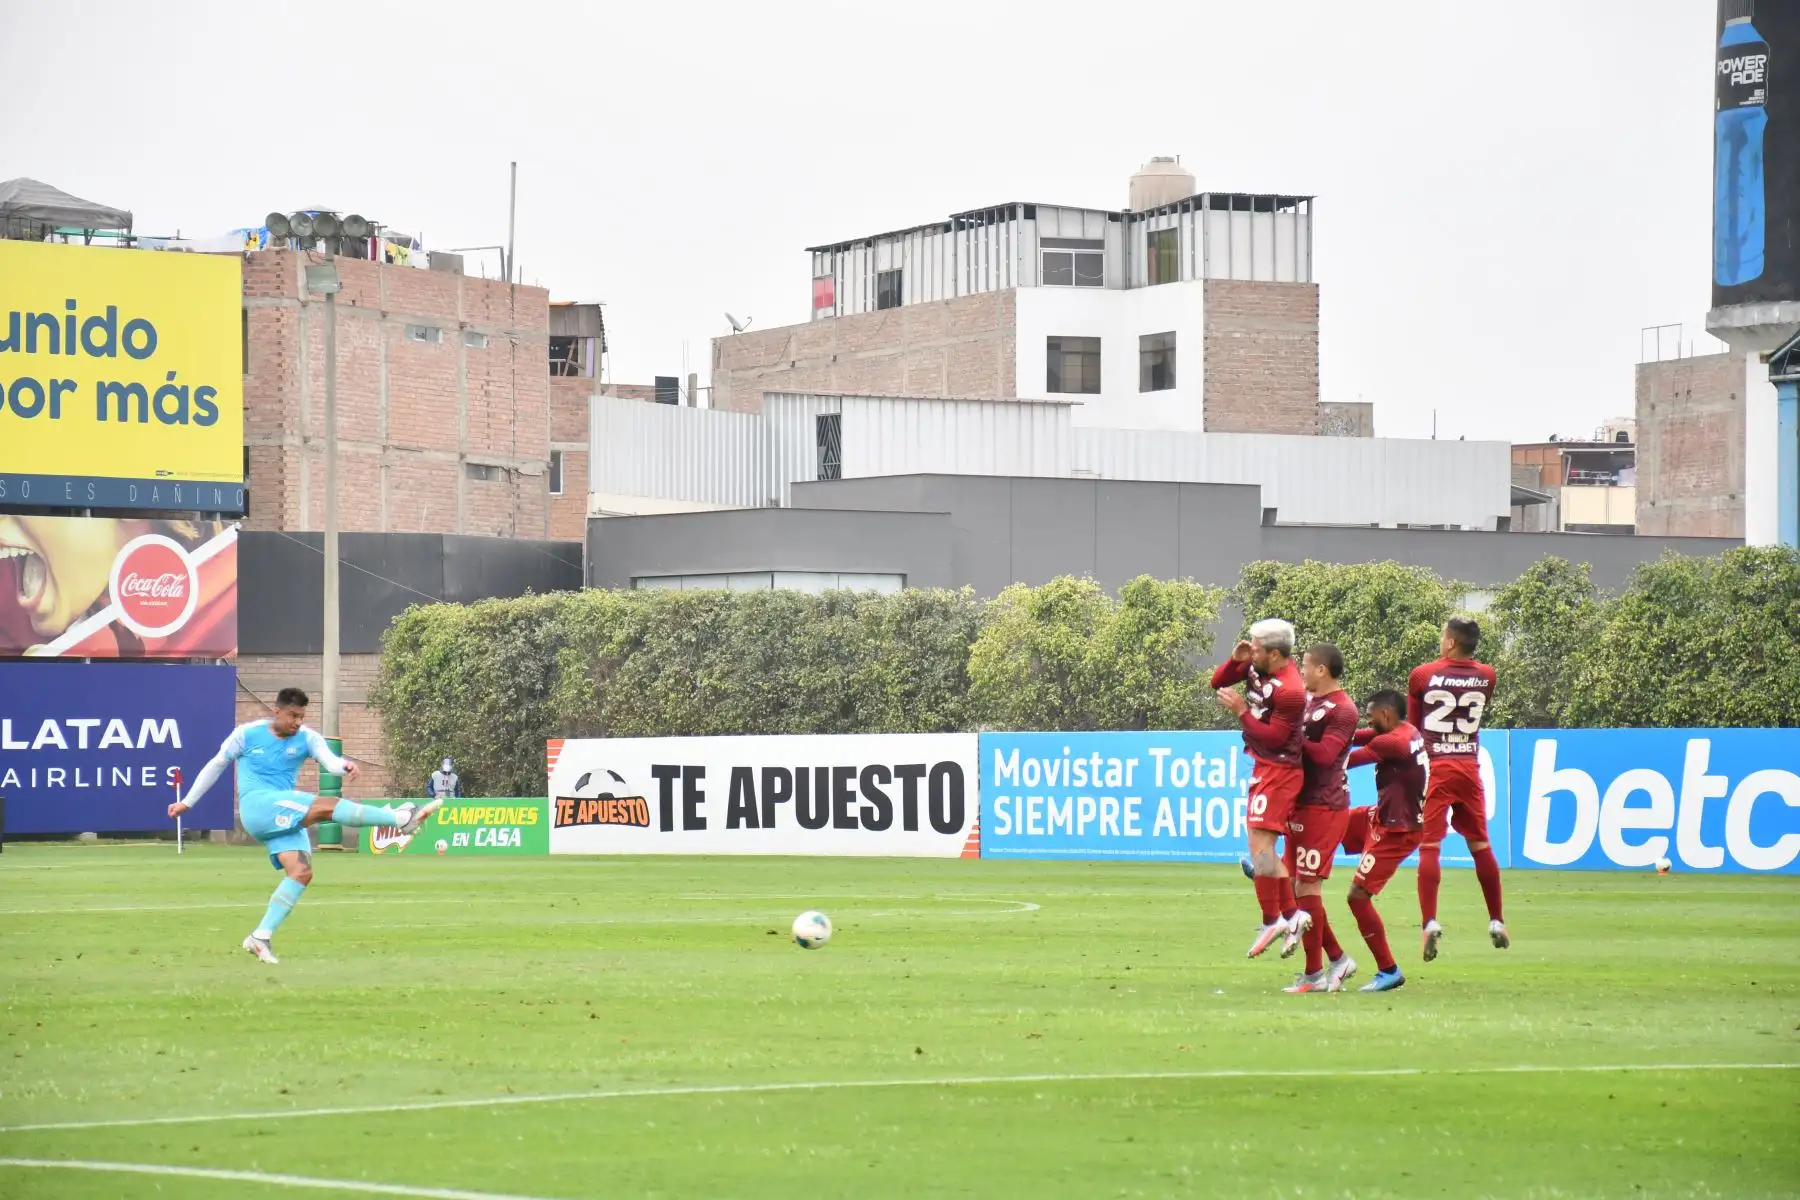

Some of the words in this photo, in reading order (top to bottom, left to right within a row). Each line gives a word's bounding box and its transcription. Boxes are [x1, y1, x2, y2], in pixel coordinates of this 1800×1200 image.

[1717, 54, 1767, 76] POWER
[1731, 68, 1765, 86] ADE
[0, 377, 78, 420] or
[96, 371, 219, 427] más
[65, 482, 95, 501] ES
[129, 484, 244, 507] DAÑINO
[121, 572, 187, 598] Coca-Cola
[1444, 677, 1490, 688] movilbus
[1424, 689, 1487, 735] 23
[1, 718, 183, 750] LATAM
[1, 766, 182, 788] AIRLINES
[993, 745, 1139, 789] Movistar
[651, 764, 707, 832] TE
[726, 761, 965, 835] APUESTO
[1523, 738, 1800, 870] betc
[437, 806, 540, 826] CAMPEONES
[555, 798, 574, 825] TE
[577, 799, 649, 827] APUESTO
[993, 796, 1143, 836] SIEMPRE
[452, 832, 470, 847] EN
[474, 827, 522, 848] CASA
[1296, 846, 1321, 870] 20
